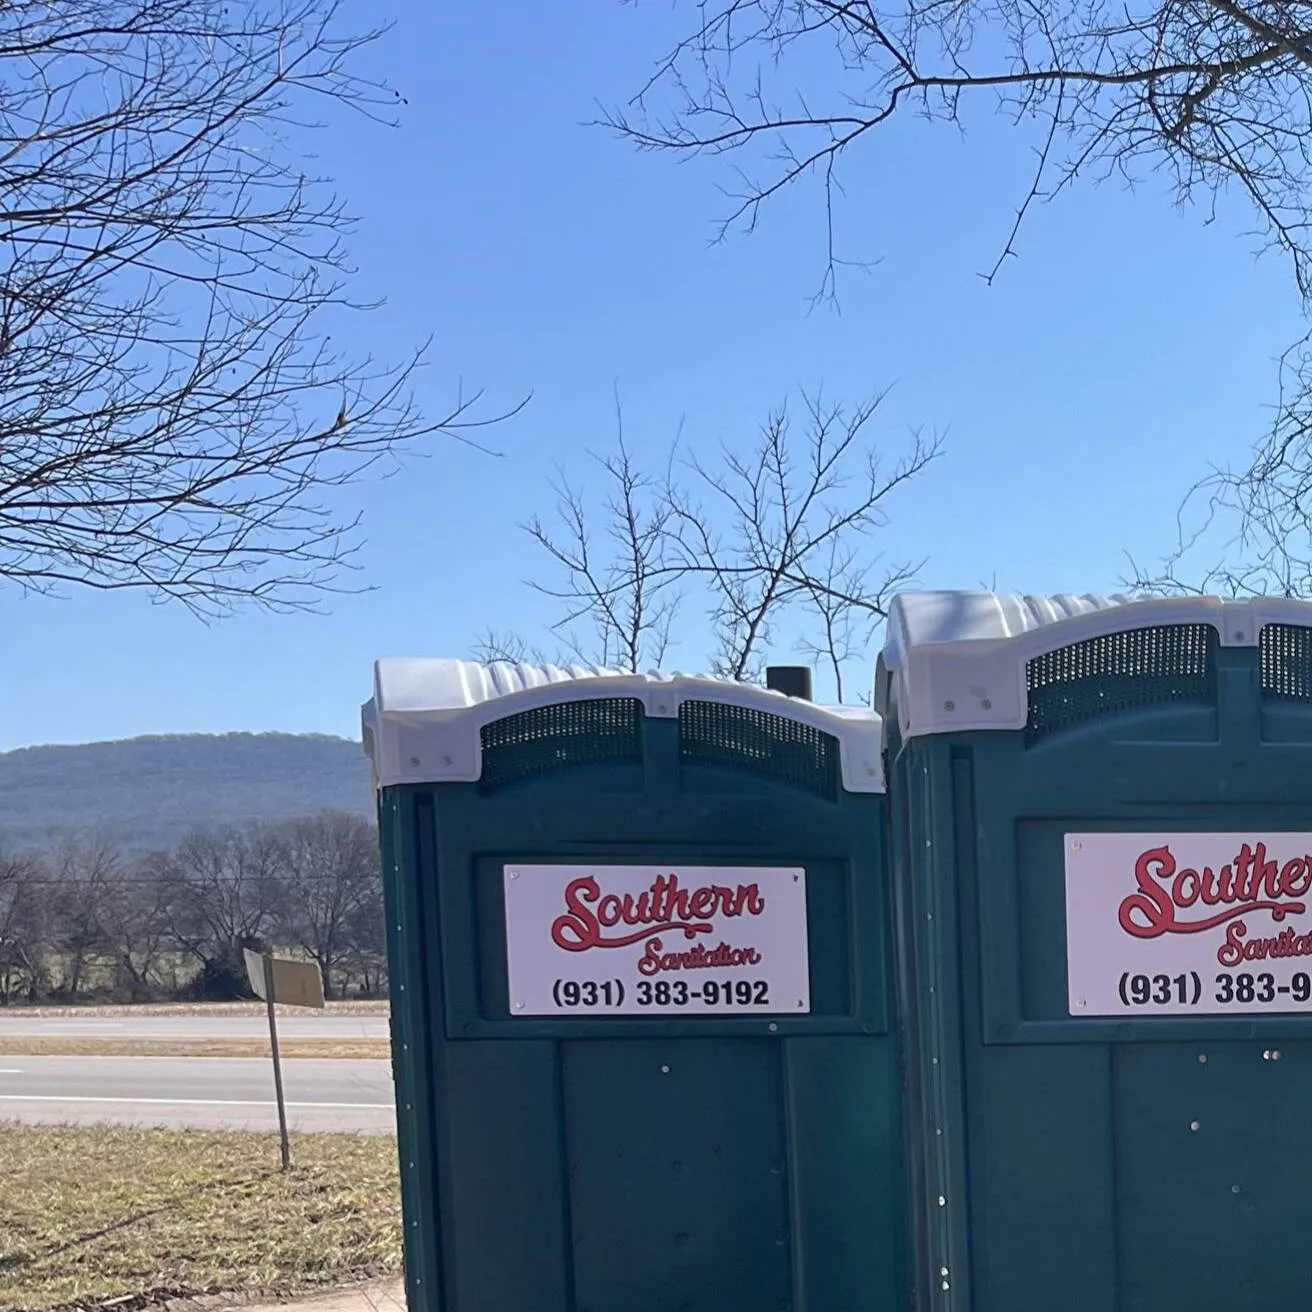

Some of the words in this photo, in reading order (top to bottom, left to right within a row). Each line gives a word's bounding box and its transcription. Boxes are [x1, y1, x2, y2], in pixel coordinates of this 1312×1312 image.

[551, 874, 764, 952] Southern
[638, 937, 761, 976] Sanitation
[552, 979, 625, 1008] (931)
[636, 980, 769, 1006] 383-9192
[1118, 971, 1201, 1006] (931)
